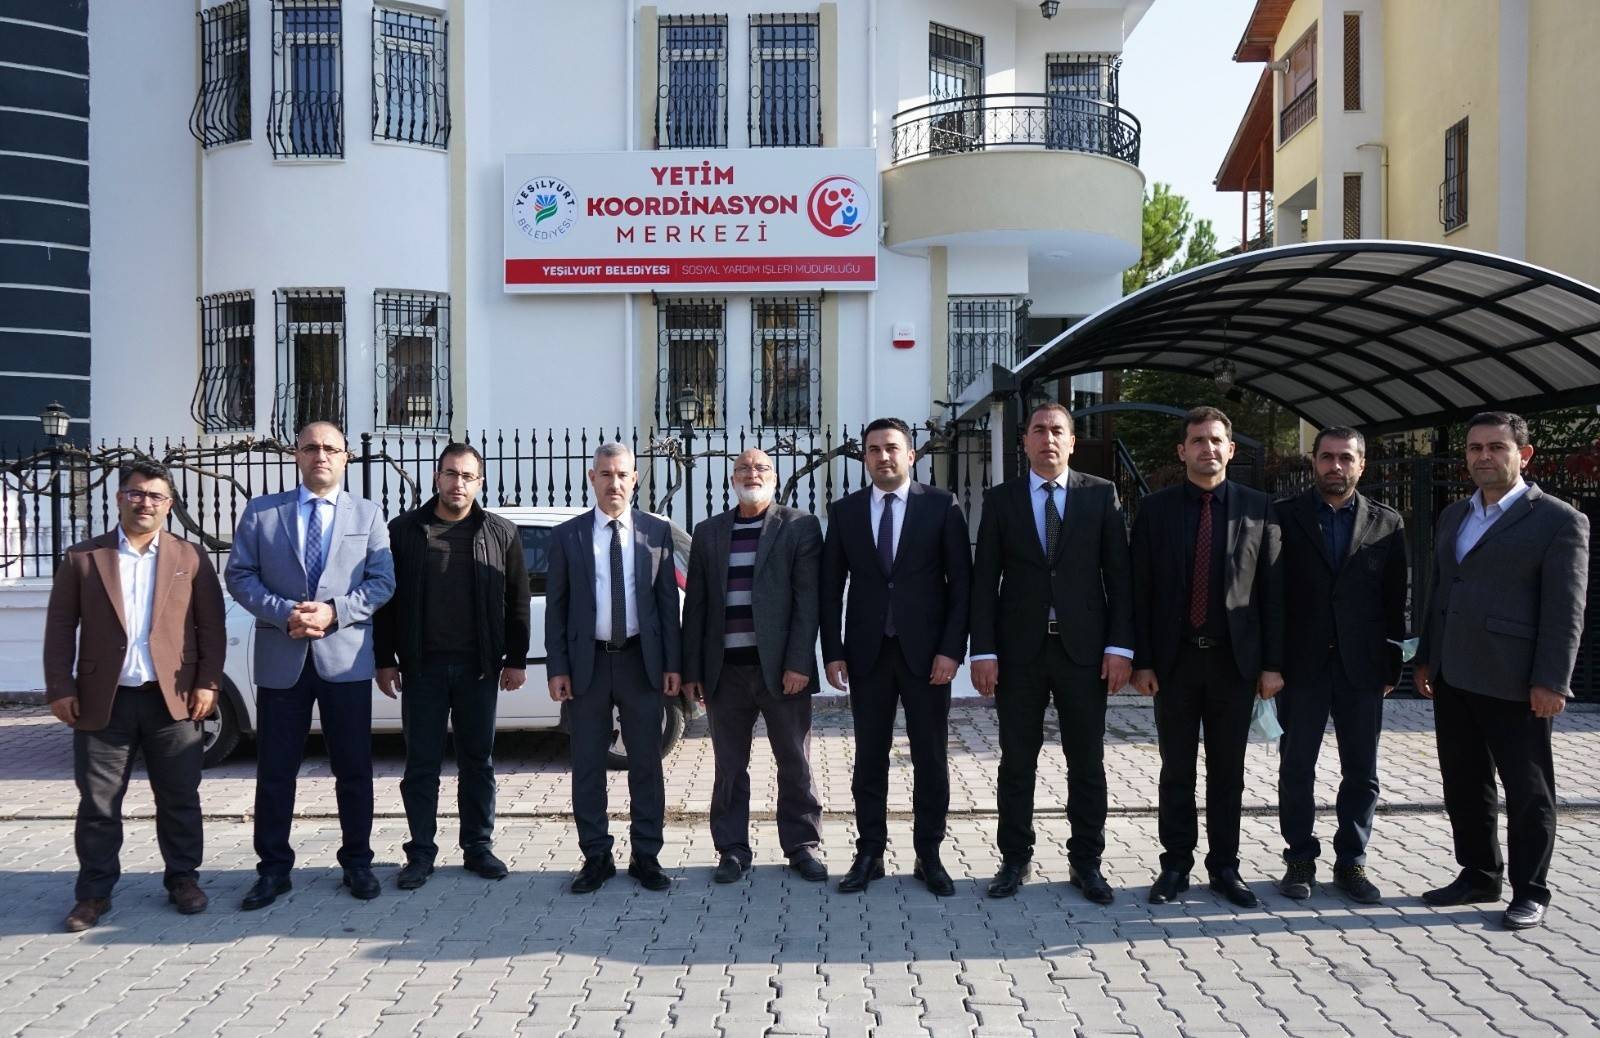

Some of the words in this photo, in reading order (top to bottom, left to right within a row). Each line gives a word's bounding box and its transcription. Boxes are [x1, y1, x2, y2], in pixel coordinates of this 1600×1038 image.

[651, 161, 733, 185] YETİM
[587, 191, 798, 216] KOORDİNASYON
[616, 221, 767, 243] MERKEZİ
[605, 265, 670, 275] BELEDİYESİ
[682, 264, 720, 275] SOSYAL
[723, 264, 760, 274] YARDIM
